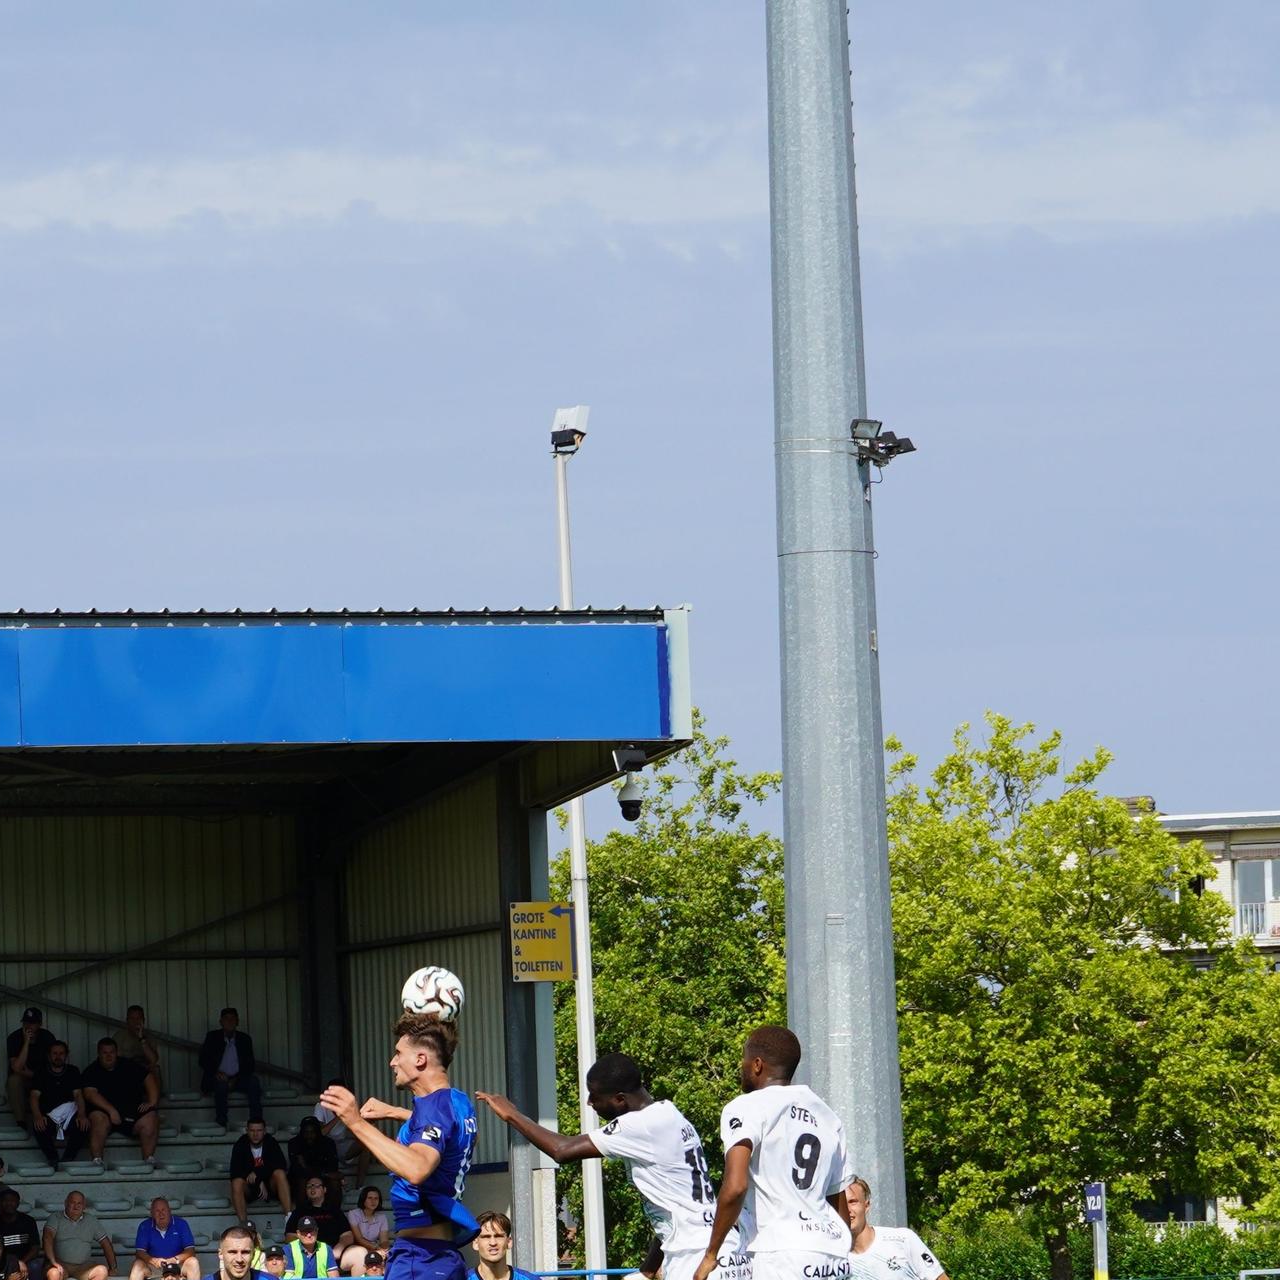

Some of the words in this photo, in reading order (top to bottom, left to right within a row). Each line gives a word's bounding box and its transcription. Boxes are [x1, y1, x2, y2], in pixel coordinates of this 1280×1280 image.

[512, 913, 545, 924] GROTE
[513, 928, 556, 940] KANTINE
[514, 945, 521, 957] &
[514, 961, 563, 973] TOILETTEN
[792, 1133, 822, 1191] 9
[1086, 1195, 1102, 1210] V2.0
[803, 1262, 851, 1279] CALLANT
